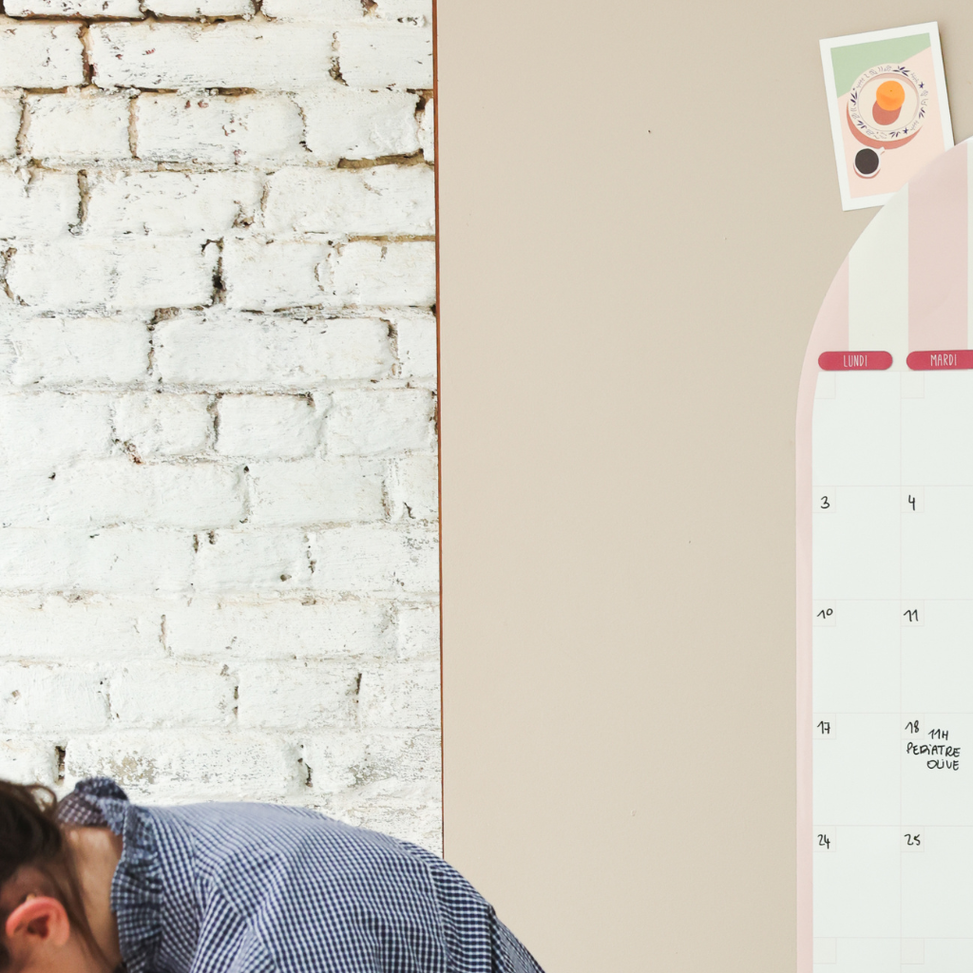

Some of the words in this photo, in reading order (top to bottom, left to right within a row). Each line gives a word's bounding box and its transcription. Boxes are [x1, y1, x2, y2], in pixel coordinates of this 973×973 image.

[843, 354, 868, 367] LUNDI
[930, 353, 958, 367] MARDI
[820, 495, 831, 510] 3
[907, 494, 917, 511] 4
[816, 607, 834, 619] 10
[903, 608, 919, 623] 11
[816, 720, 831, 735] 17
[904, 719, 920, 734] 18
[927, 728, 949, 741] 11H
[817, 833, 832, 850] 24
[904, 833, 921, 846] 25
